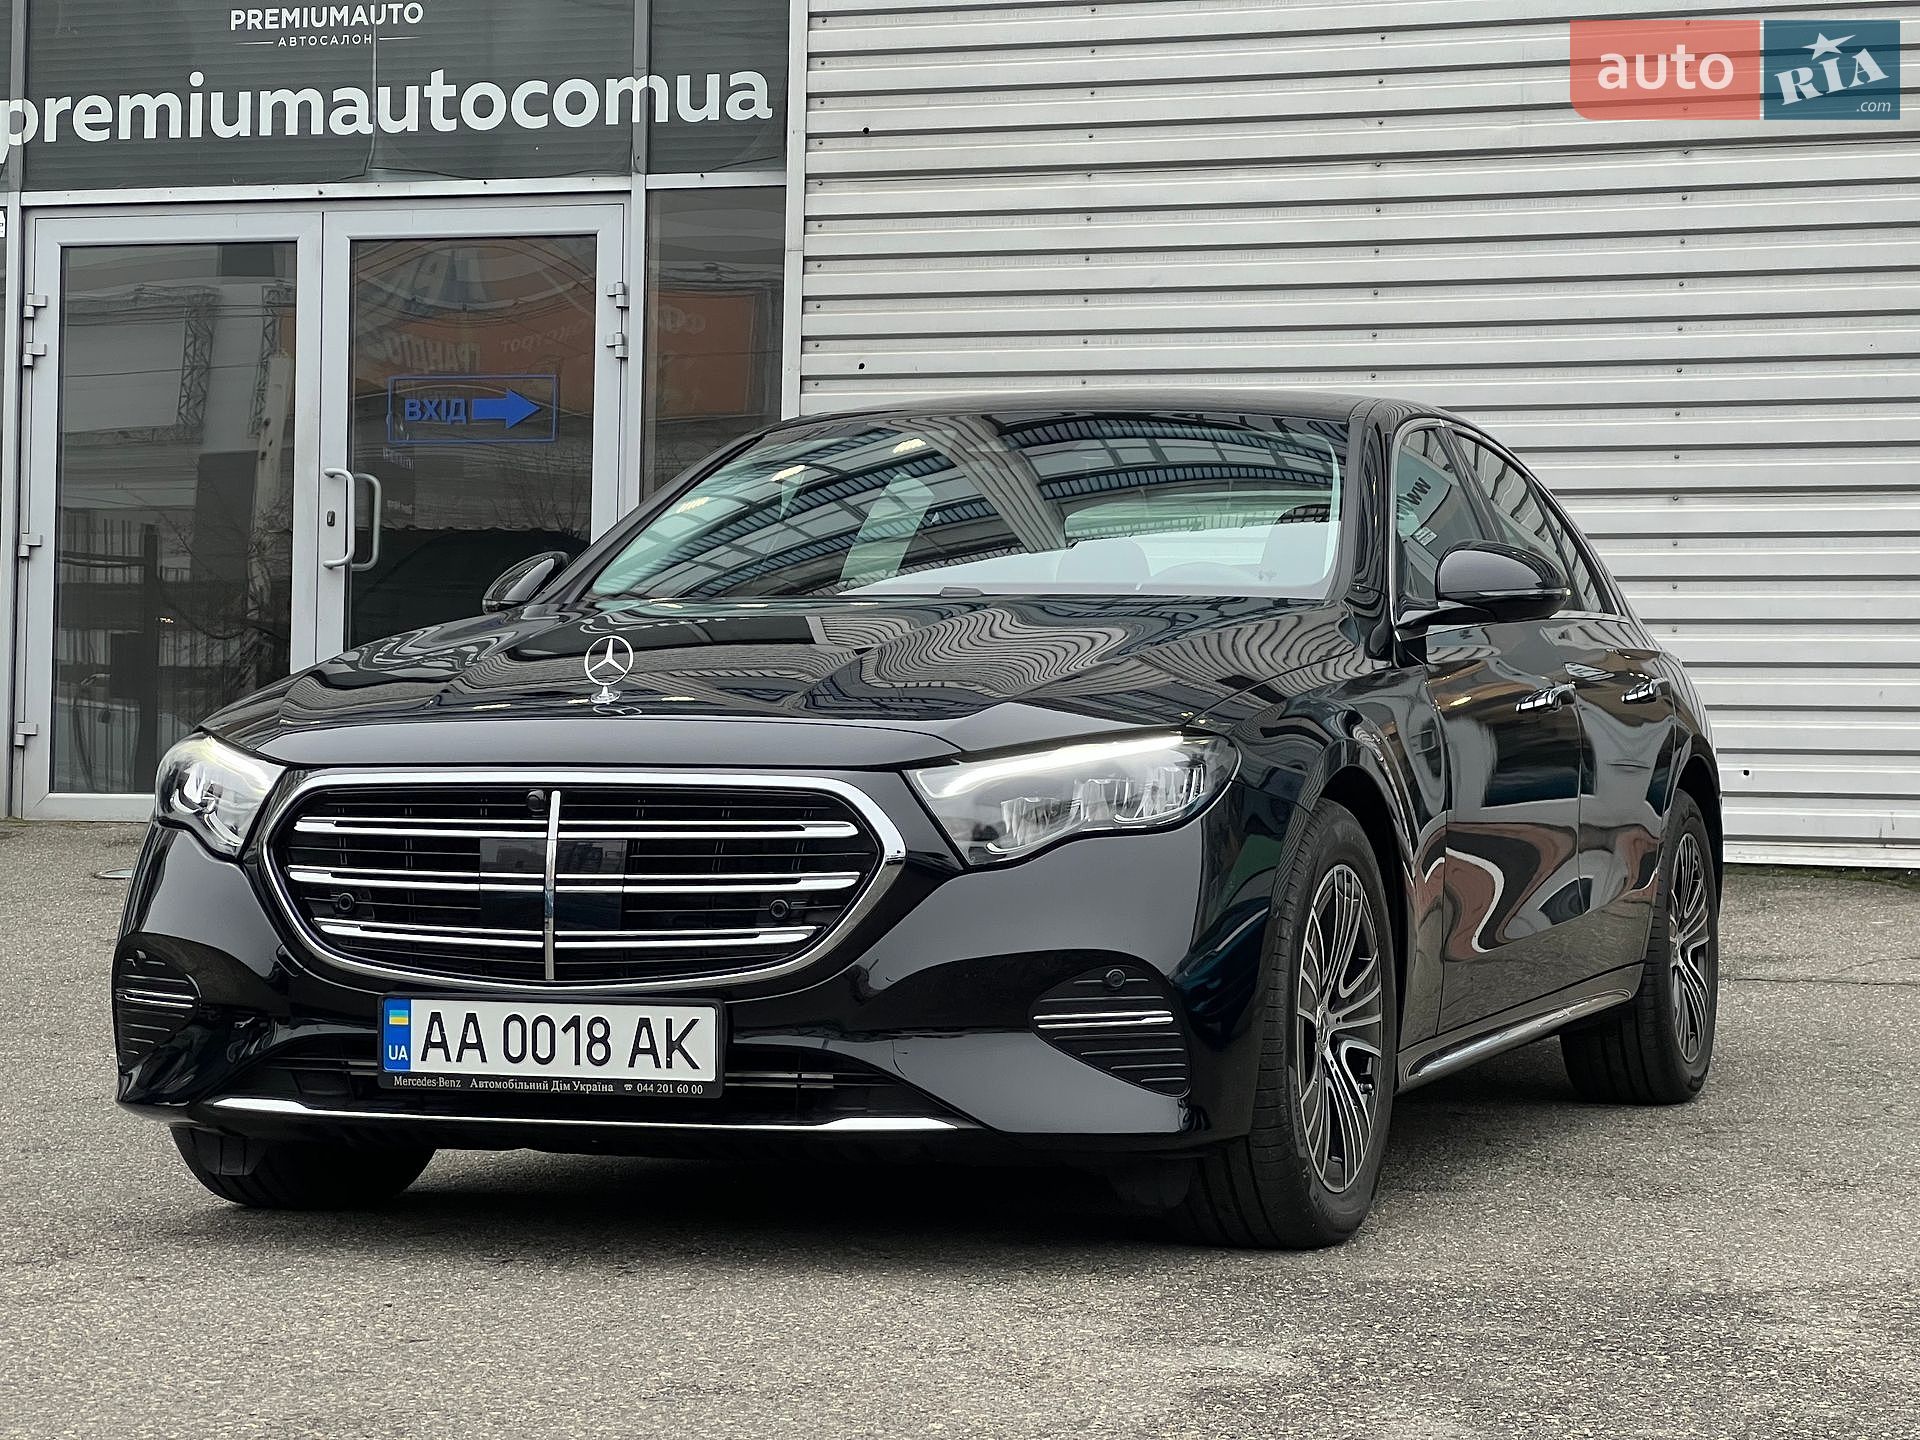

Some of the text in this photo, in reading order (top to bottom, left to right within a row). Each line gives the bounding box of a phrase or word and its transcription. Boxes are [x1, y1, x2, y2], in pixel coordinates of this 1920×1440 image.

[230, 2, 424, 31] PREMIUMAUTO
[278, 33, 372, 47] АВТОСАЛОН
[404, 398, 468, 425] ВХІД
[420, 1011, 701, 1071] AA 0018 AK
[388, 1045, 409, 1062] UA
[394, 1076, 704, 1095] Mercedes-Benz Автомобільний Дім Україна 044 201 60 00
